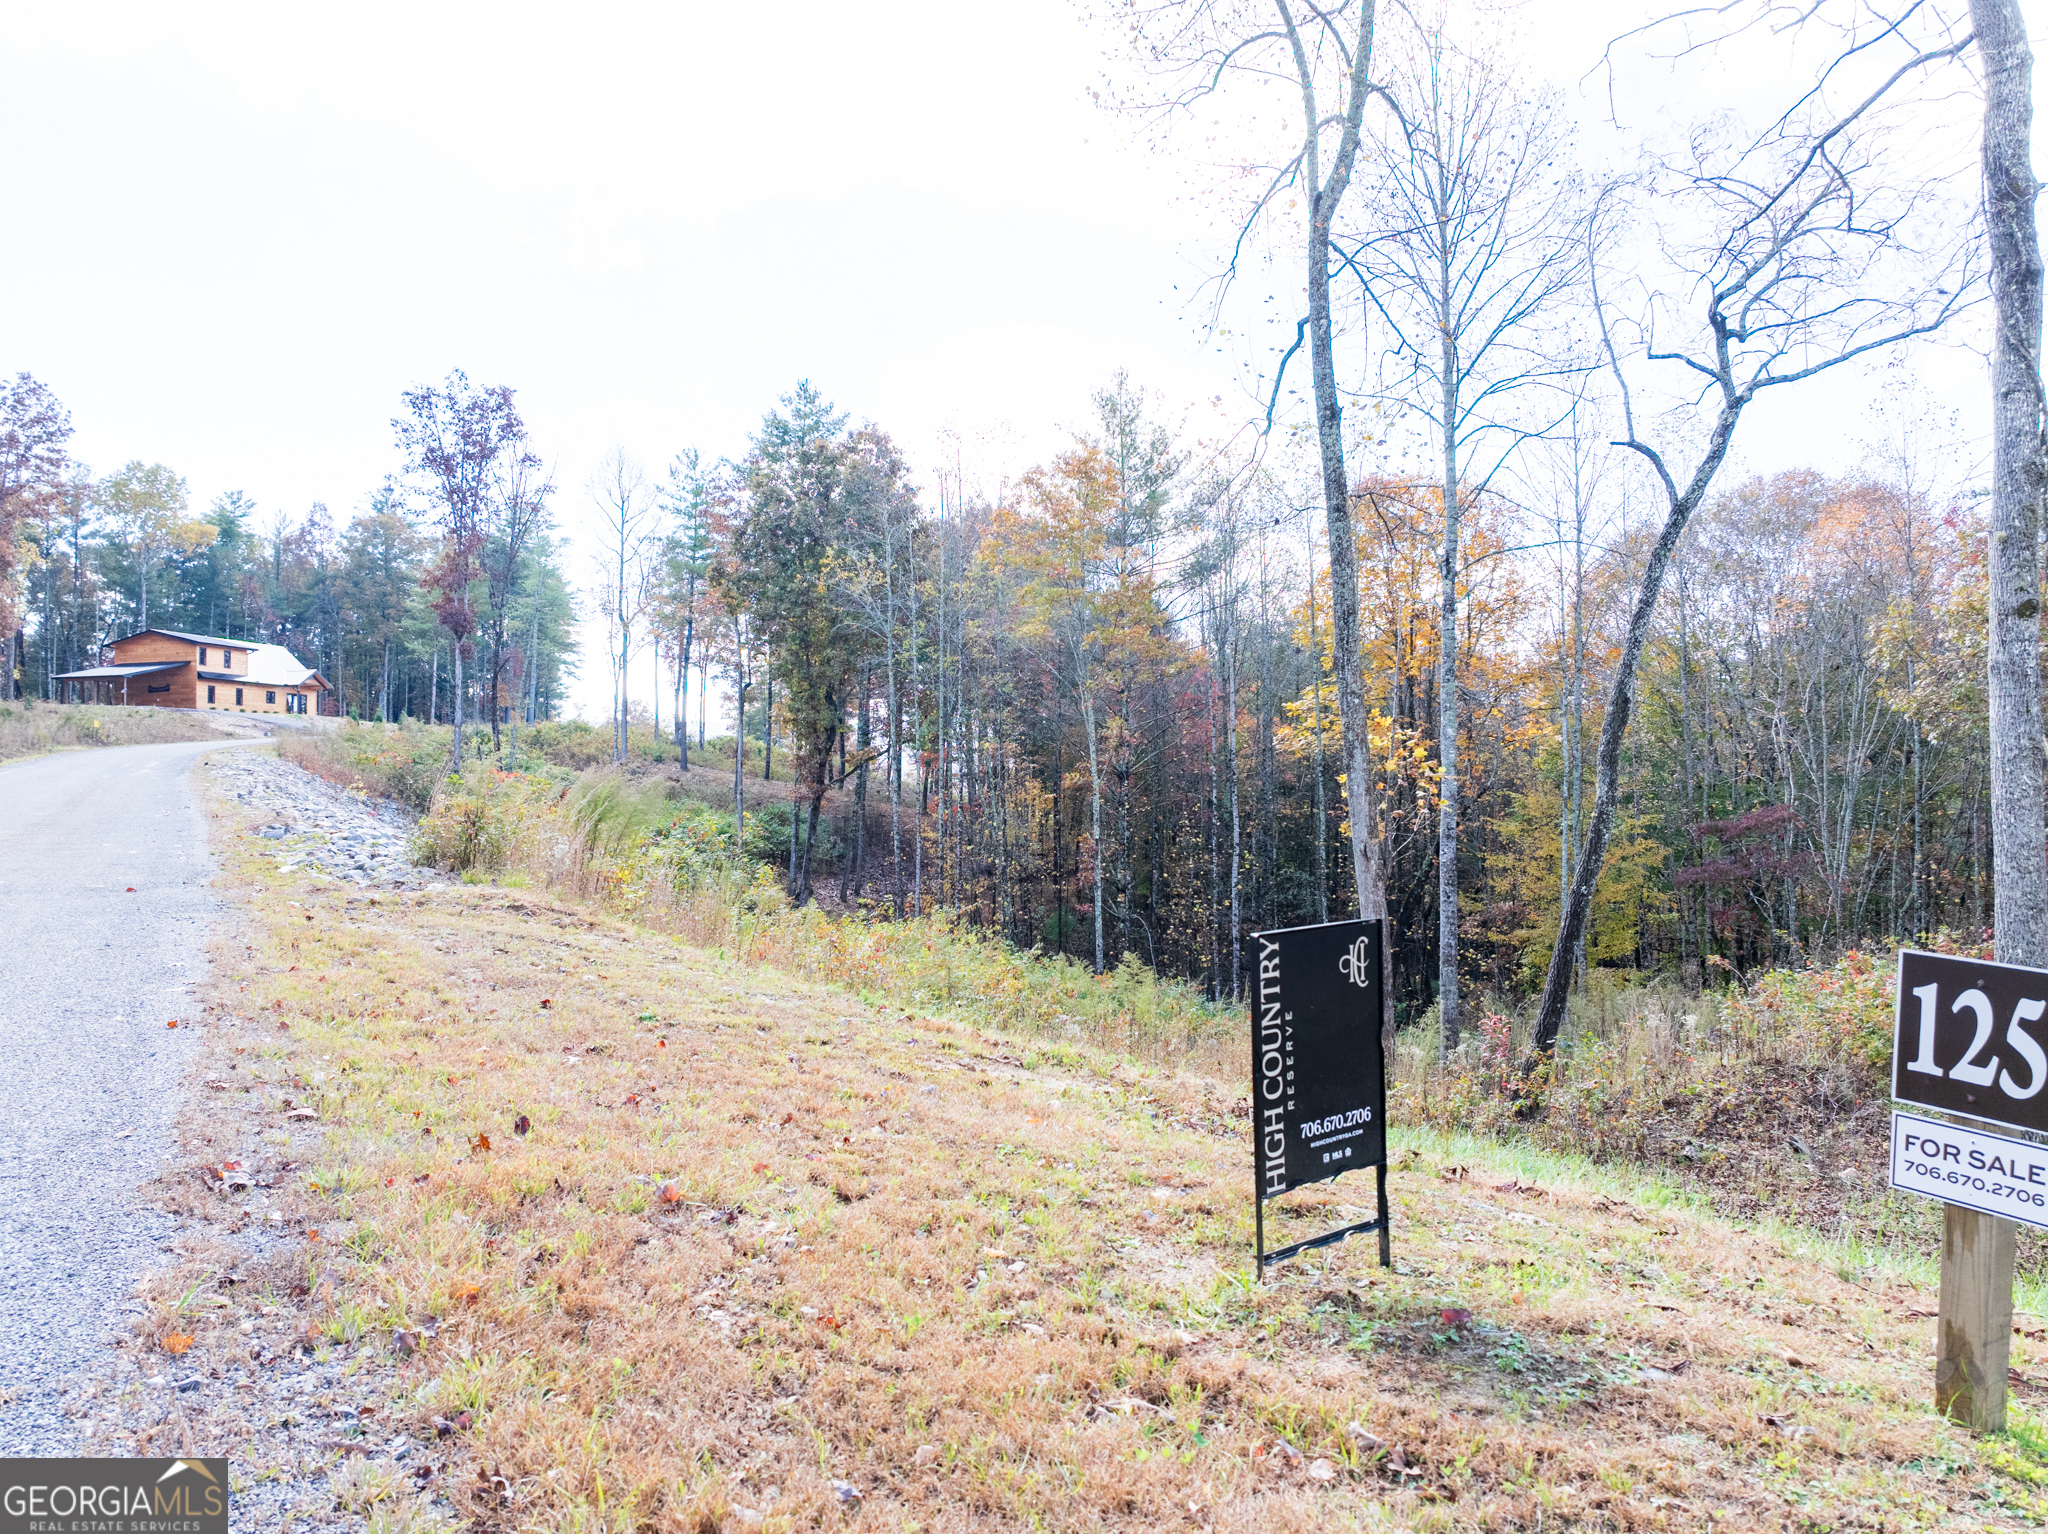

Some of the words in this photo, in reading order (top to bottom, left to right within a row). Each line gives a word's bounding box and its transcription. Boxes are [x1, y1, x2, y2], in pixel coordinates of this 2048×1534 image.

[1259, 937, 1284, 1100] COUNTRY
[1907, 982, 2047, 1100] 125
[1285, 1010, 1295, 1110] RESERVE
[1264, 1105, 1286, 1195] HIGH
[1300, 1106, 1371, 1139] 706.670.2706
[1310, 1128, 1364, 1148] HIGHCOUNTRYGA.COM
[1904, 1134, 1961, 1165] FOR
[1968, 1150, 2046, 1186] SALE
[1904, 1160, 2046, 1207] 706.670.2706
